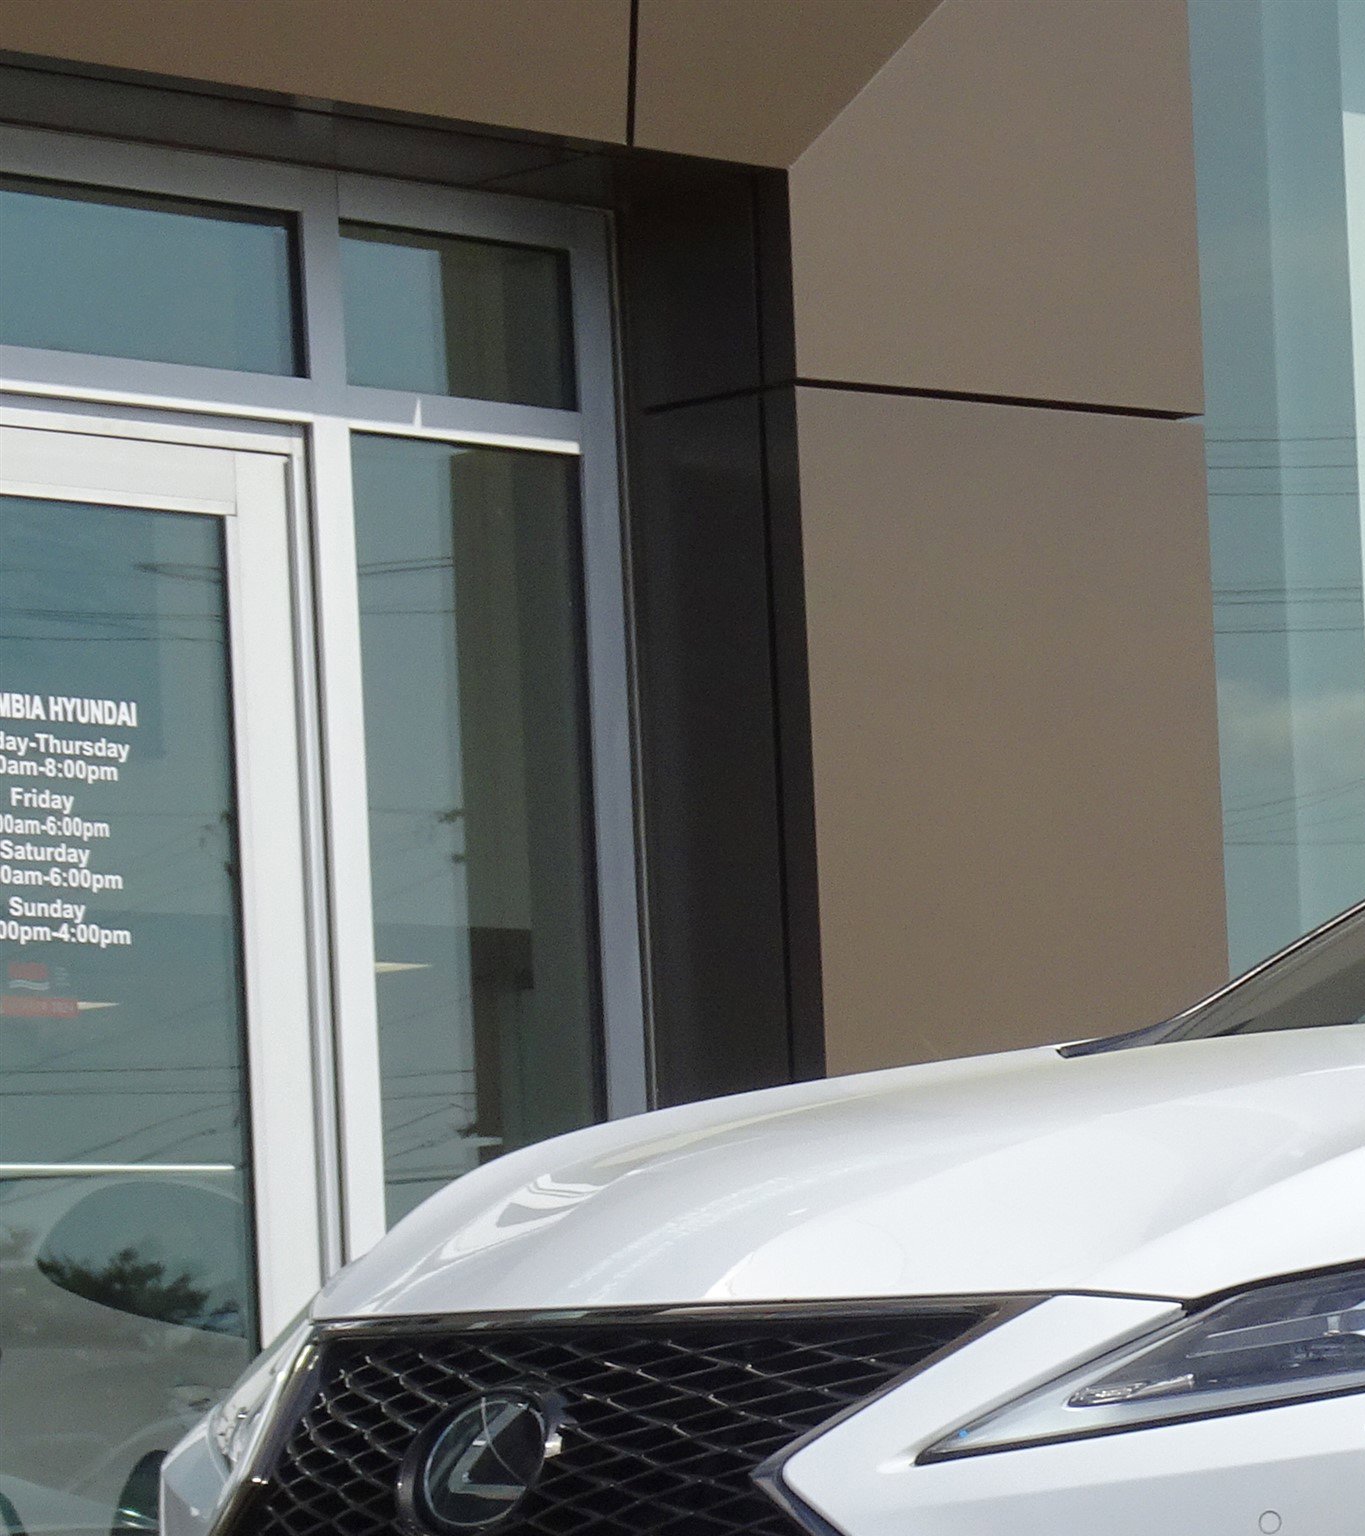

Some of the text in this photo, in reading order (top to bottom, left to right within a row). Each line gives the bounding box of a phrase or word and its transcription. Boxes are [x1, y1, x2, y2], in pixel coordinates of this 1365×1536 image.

[48, 695, 138, 728] HYUNDAI
[10, 786, 75, 815] Friday
[0, 839, 91, 867] Saturday
[8, 896, 86, 924] Sunday
